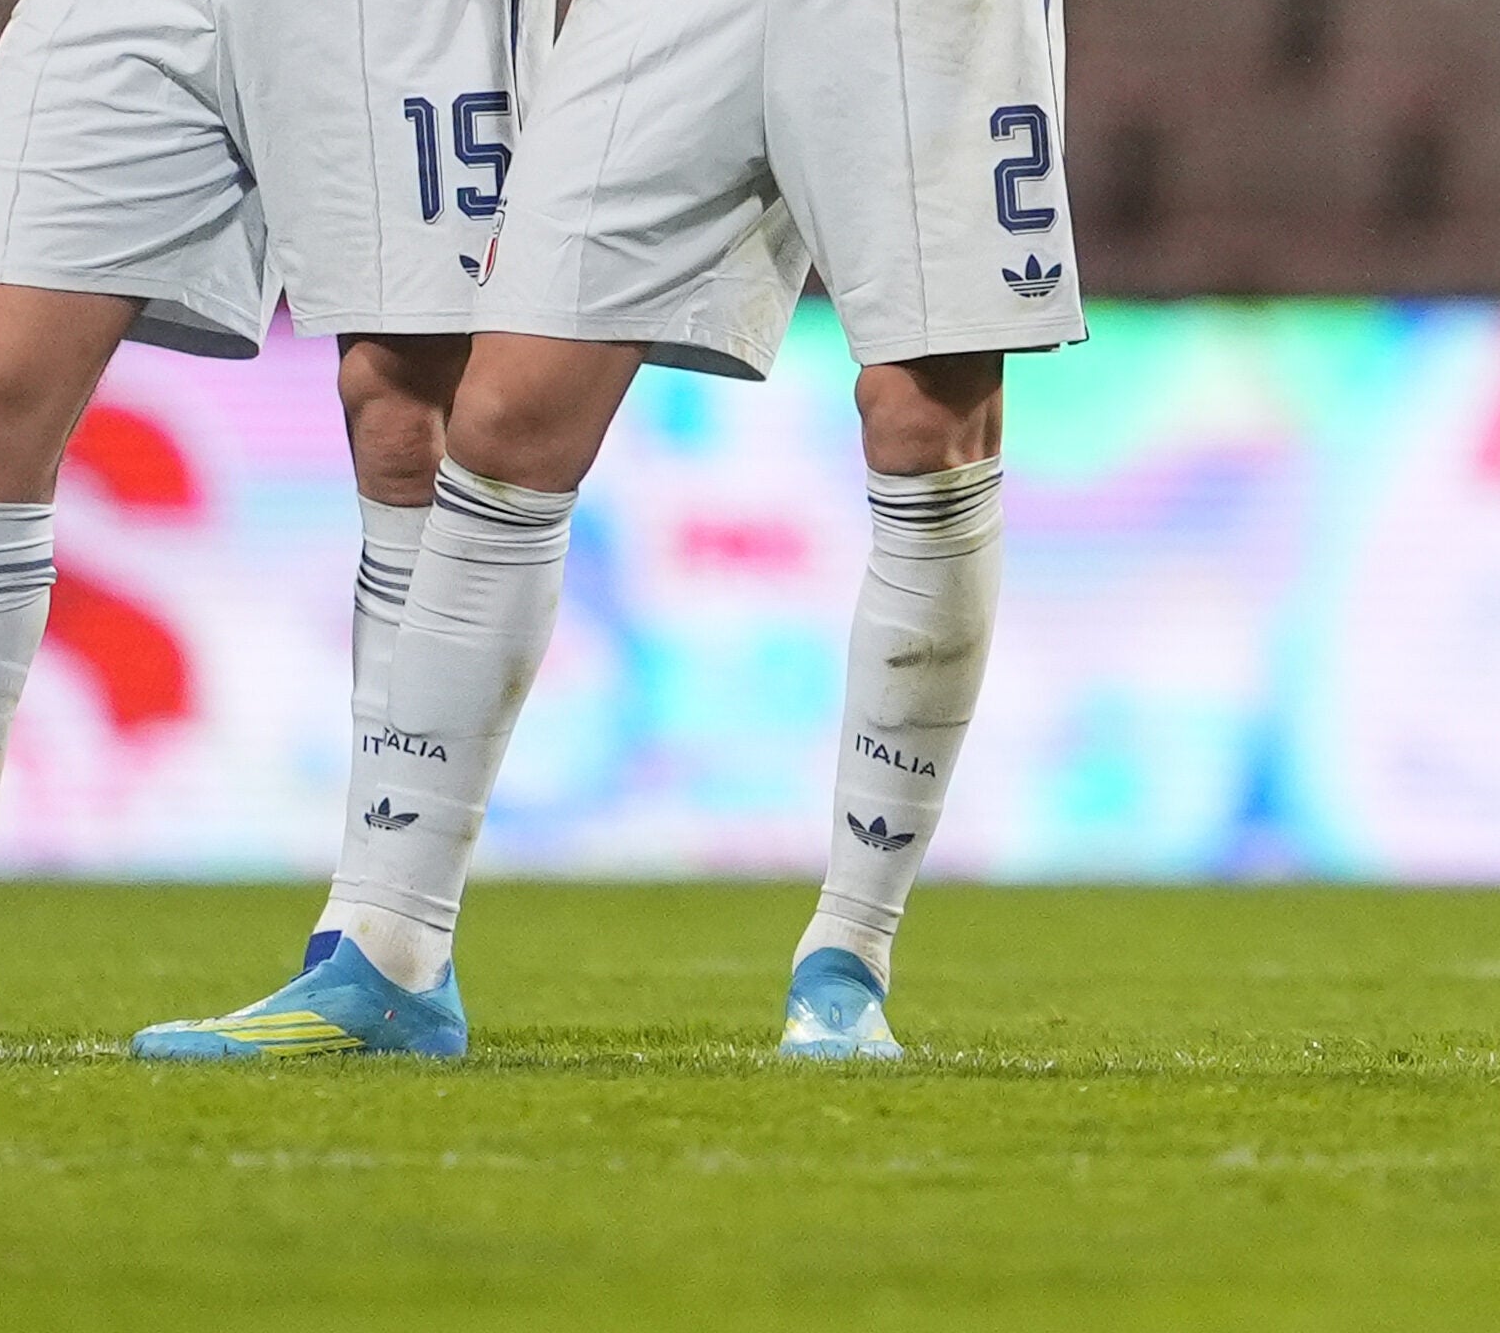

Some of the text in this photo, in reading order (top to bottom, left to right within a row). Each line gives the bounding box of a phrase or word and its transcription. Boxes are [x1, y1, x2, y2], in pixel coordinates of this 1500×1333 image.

[404, 91, 512, 224] 15
[989, 103, 1062, 235] 2
[856, 734, 936, 778] ITALIA
